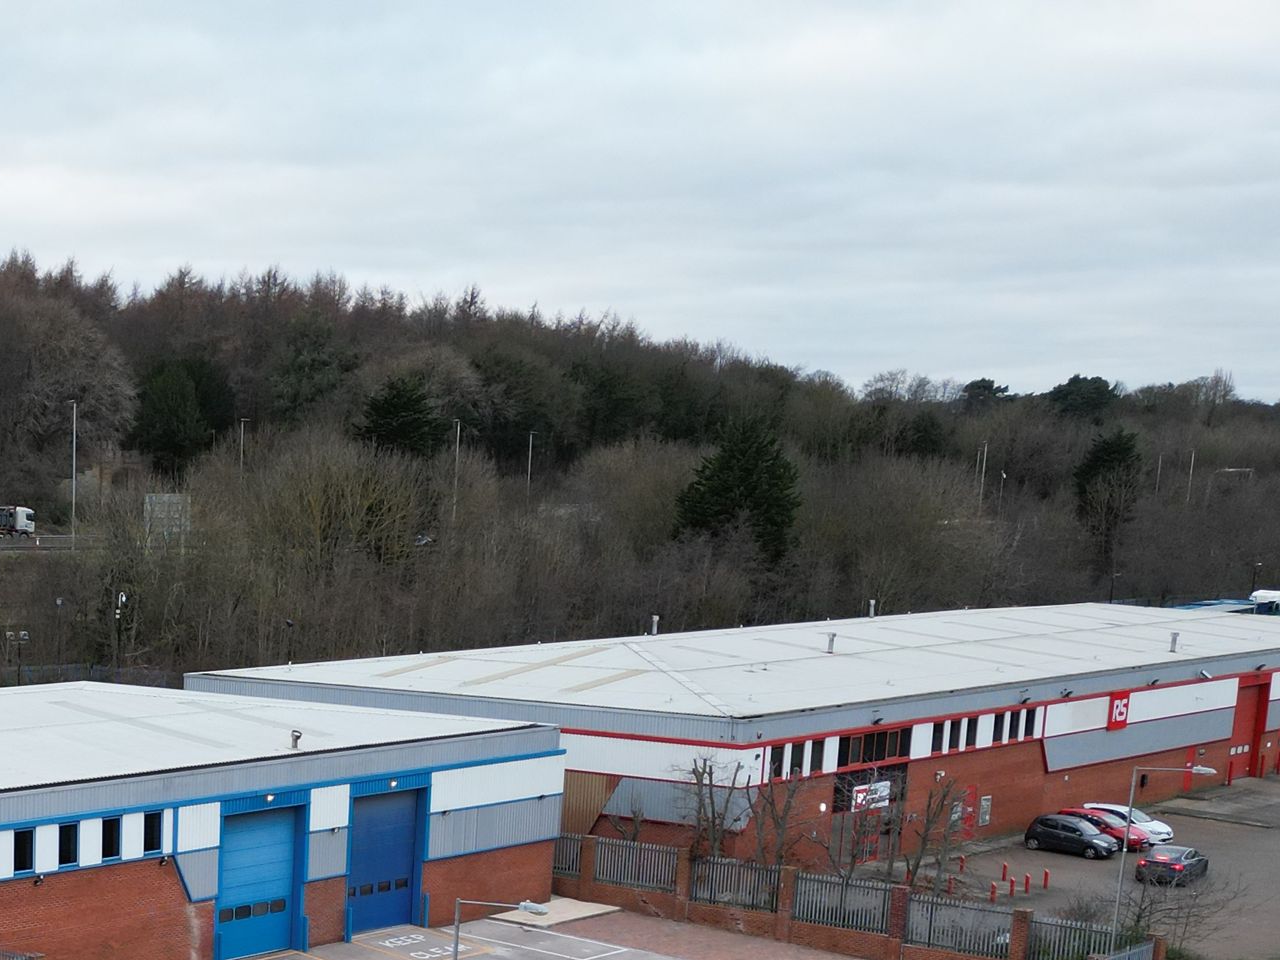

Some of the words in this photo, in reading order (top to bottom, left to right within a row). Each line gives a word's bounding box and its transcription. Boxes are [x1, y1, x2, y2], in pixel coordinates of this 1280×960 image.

[1112, 698, 1128, 722] RS
[378, 933, 426, 949] KEEP
[409, 943, 472, 960] CLEAR
